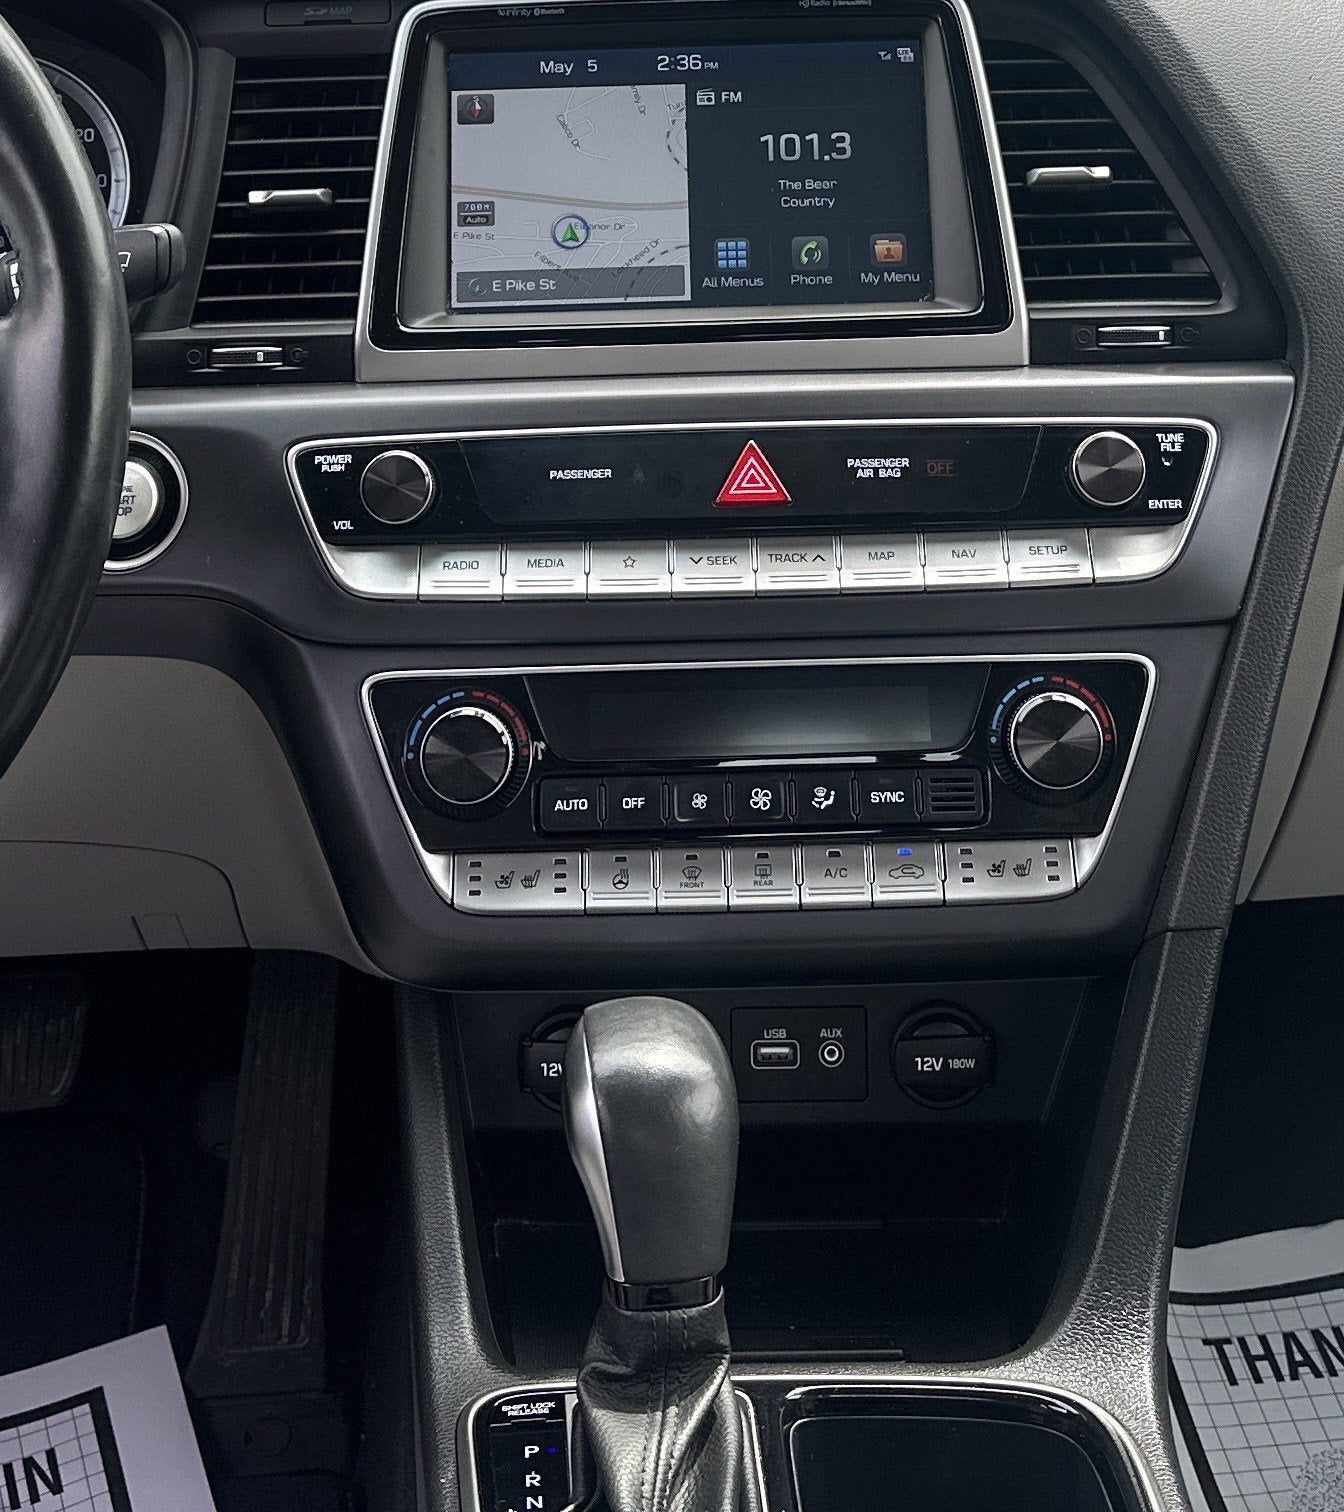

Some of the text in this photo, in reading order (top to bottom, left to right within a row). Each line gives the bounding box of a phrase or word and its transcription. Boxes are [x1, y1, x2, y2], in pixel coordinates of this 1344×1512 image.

[330, 6, 353, 16] MAP
[539, 59, 598, 76] May 5
[657, 53, 719, 72] 2:36 PM
[721, 91, 742, 103] FM
[760, 131, 852, 162] 101.3
[778, 178, 838, 190] The Bear
[781, 196, 836, 209] Country
[465, 215, 487, 224] Auto
[613, 222, 626, 231] Dr
[702, 276, 764, 288] All Menus
[791, 274, 833, 286] Phone
[861, 271, 921, 285] My Menu
[492, 278, 557, 292] E Pike St
[1155, 433, 1185, 443] TUNE
[1160, 442, 1182, 452] FILE
[314, 454, 352, 465] POWER
[846, 457, 910, 469] PASSENGER
[321, 464, 346, 473] PUSH
[549, 468, 613, 480] PASSENGER
[856, 468, 901, 478] AIR BAG
[926, 461, 954, 475] OFF
[1148, 499, 1183, 510] ENTER
[333, 520, 354, 531] VOL
[868, 550, 895, 561] MAP
[951, 548, 977, 559] NAV
[1028, 545, 1068, 556] SETUP
[526, 557, 565, 569] MEDIA
[706, 554, 738, 566] SEEK
[768, 552, 808, 564] TRACK
[442, 560, 480, 571] RADIO
[622, 797, 646, 809] OFF
[870, 791, 905, 804] SYNC
[554, 799, 588, 812] AUTO
[824, 865, 848, 879] A/C
[679, 881, 705, 889] FRONT
[753, 879, 774, 887] REAR
[763, 1028, 787, 1039] USB
[819, 1027, 843, 1038] AUX
[914, 1056, 975, 1071] 12V 180W
[530, 1401, 556, 1409] LOCK
[524, 1445, 540, 1459] P
[2, 1447, 64, 1511] IN
[525, 1472, 542, 1488] R
[526, 1495, 544, 1510] N
